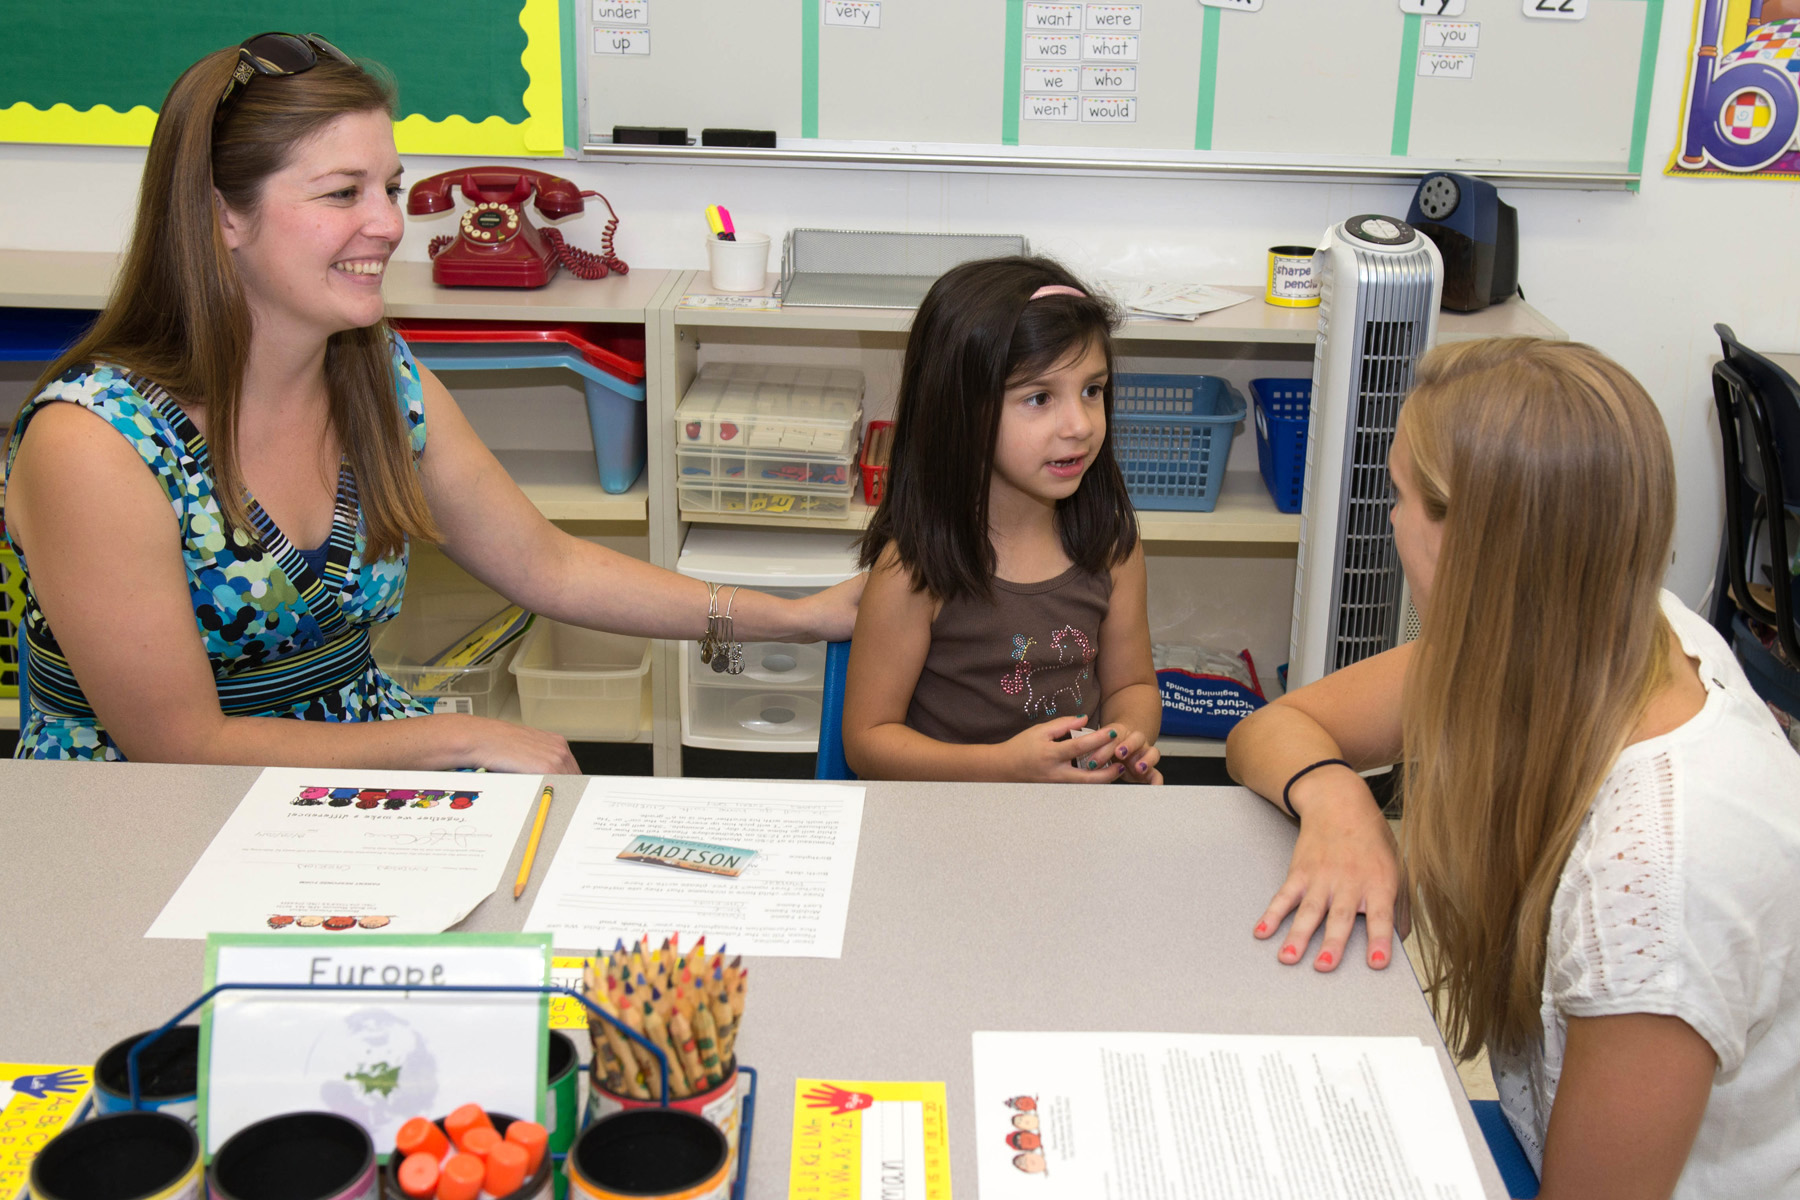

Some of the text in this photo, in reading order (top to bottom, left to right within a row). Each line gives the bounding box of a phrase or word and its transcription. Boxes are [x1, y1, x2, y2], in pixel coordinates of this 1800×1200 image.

[598, 4, 641, 19] under
[835, 7, 871, 24] very
[1037, 11, 1073, 26] want
[1095, 14, 1132, 25] were
[612, 37, 631, 54] up
[1440, 30, 1467, 47] you
[1039, 44, 1067, 55] was
[1092, 41, 1128, 55] what
[1431, 59, 1464, 75] your
[1044, 77, 1063, 88] we
[1095, 72, 1123, 87] who
[1033, 102, 1068, 116] went
[1089, 103, 1129, 117] would
[1165, 681, 1240, 698] Beginning Sounds
[1174, 693, 1214, 707] Sorting
[633, 842, 742, 869] MADISON
[309, 957, 447, 998] Europe
